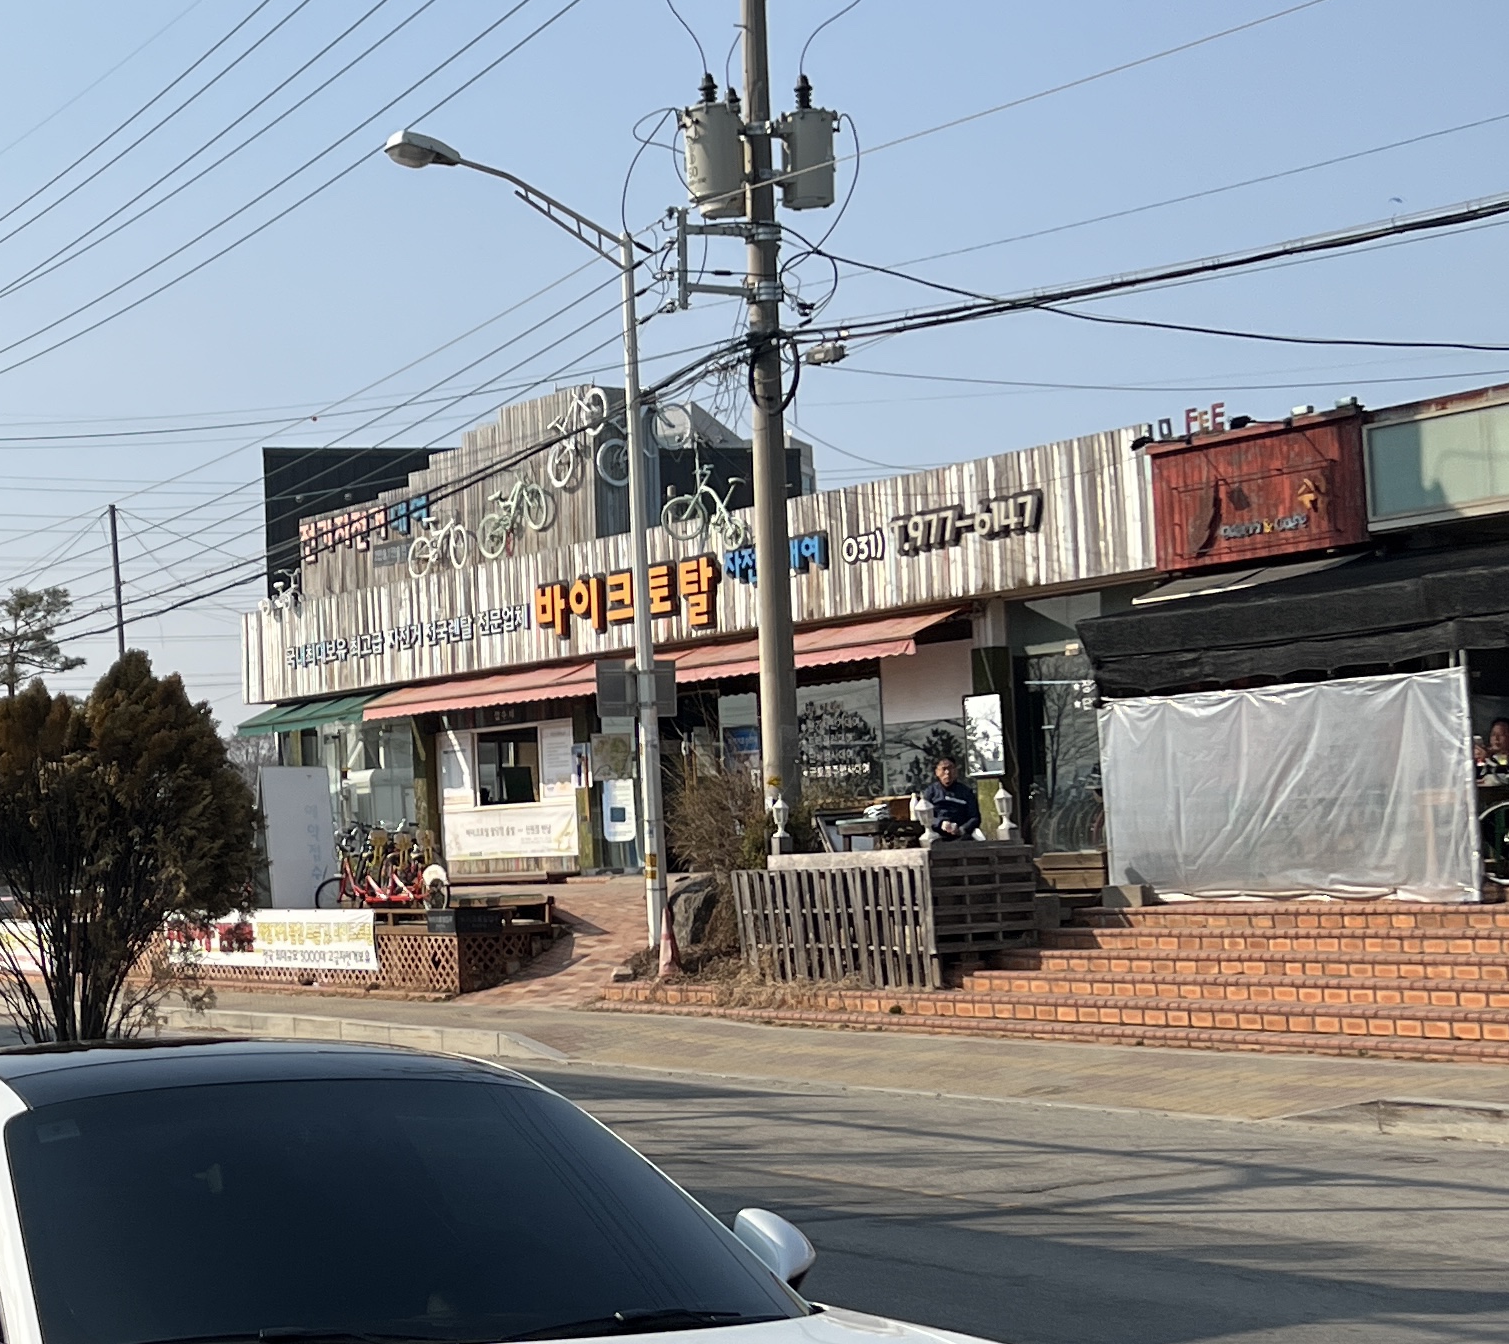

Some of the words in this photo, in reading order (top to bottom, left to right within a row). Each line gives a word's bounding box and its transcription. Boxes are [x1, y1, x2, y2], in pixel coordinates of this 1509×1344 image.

[842, 528, 885, 564] 031)
[535, 555, 715, 637] 바이크토탈
[349, 631, 385, 657] 최고급
[387, 624, 424, 651] 자전거
[477, 604, 531, 636] 전문업체
